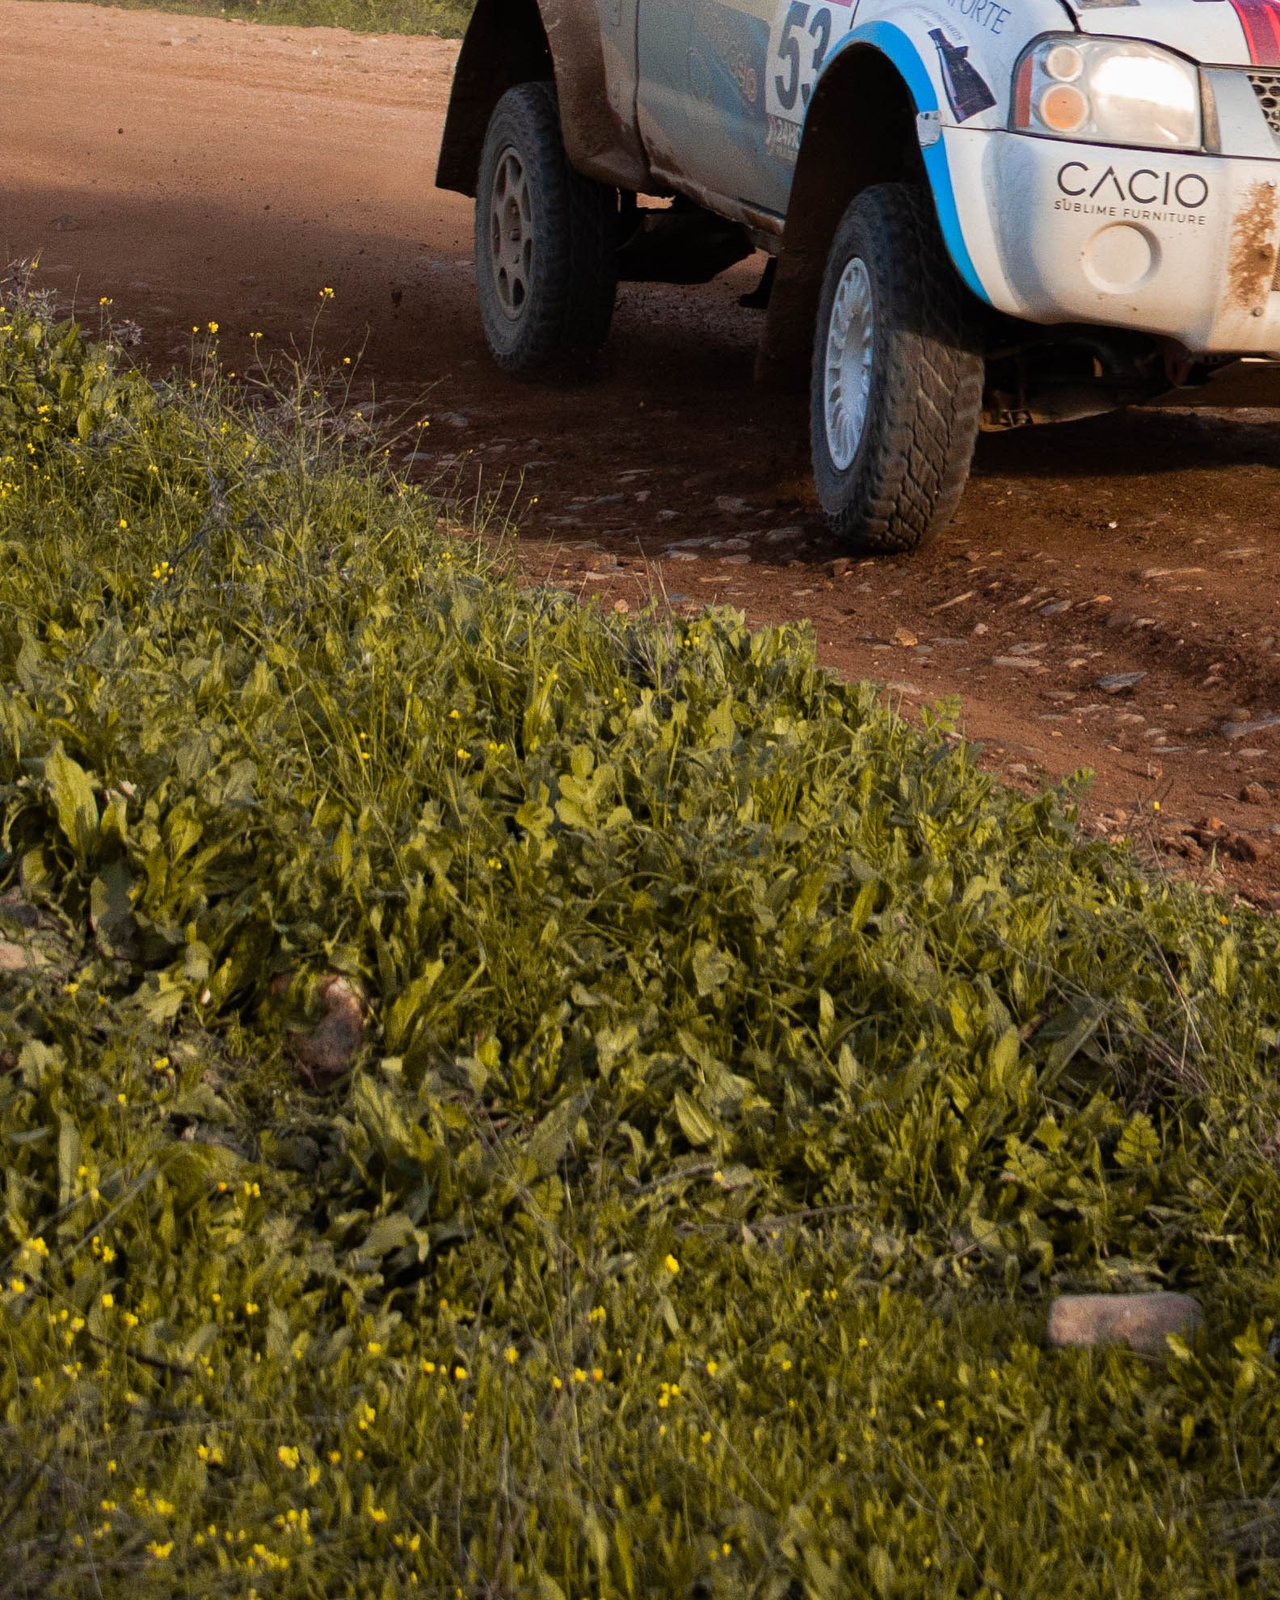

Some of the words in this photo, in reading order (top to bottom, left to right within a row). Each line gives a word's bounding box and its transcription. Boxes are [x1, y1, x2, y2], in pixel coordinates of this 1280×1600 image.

[774, 0, 832, 111] 53
[1057, 161, 1209, 208] CACIO
[1054, 200, 1117, 217] SUBLIME
[1123, 208, 1206, 226] FURNITURE
